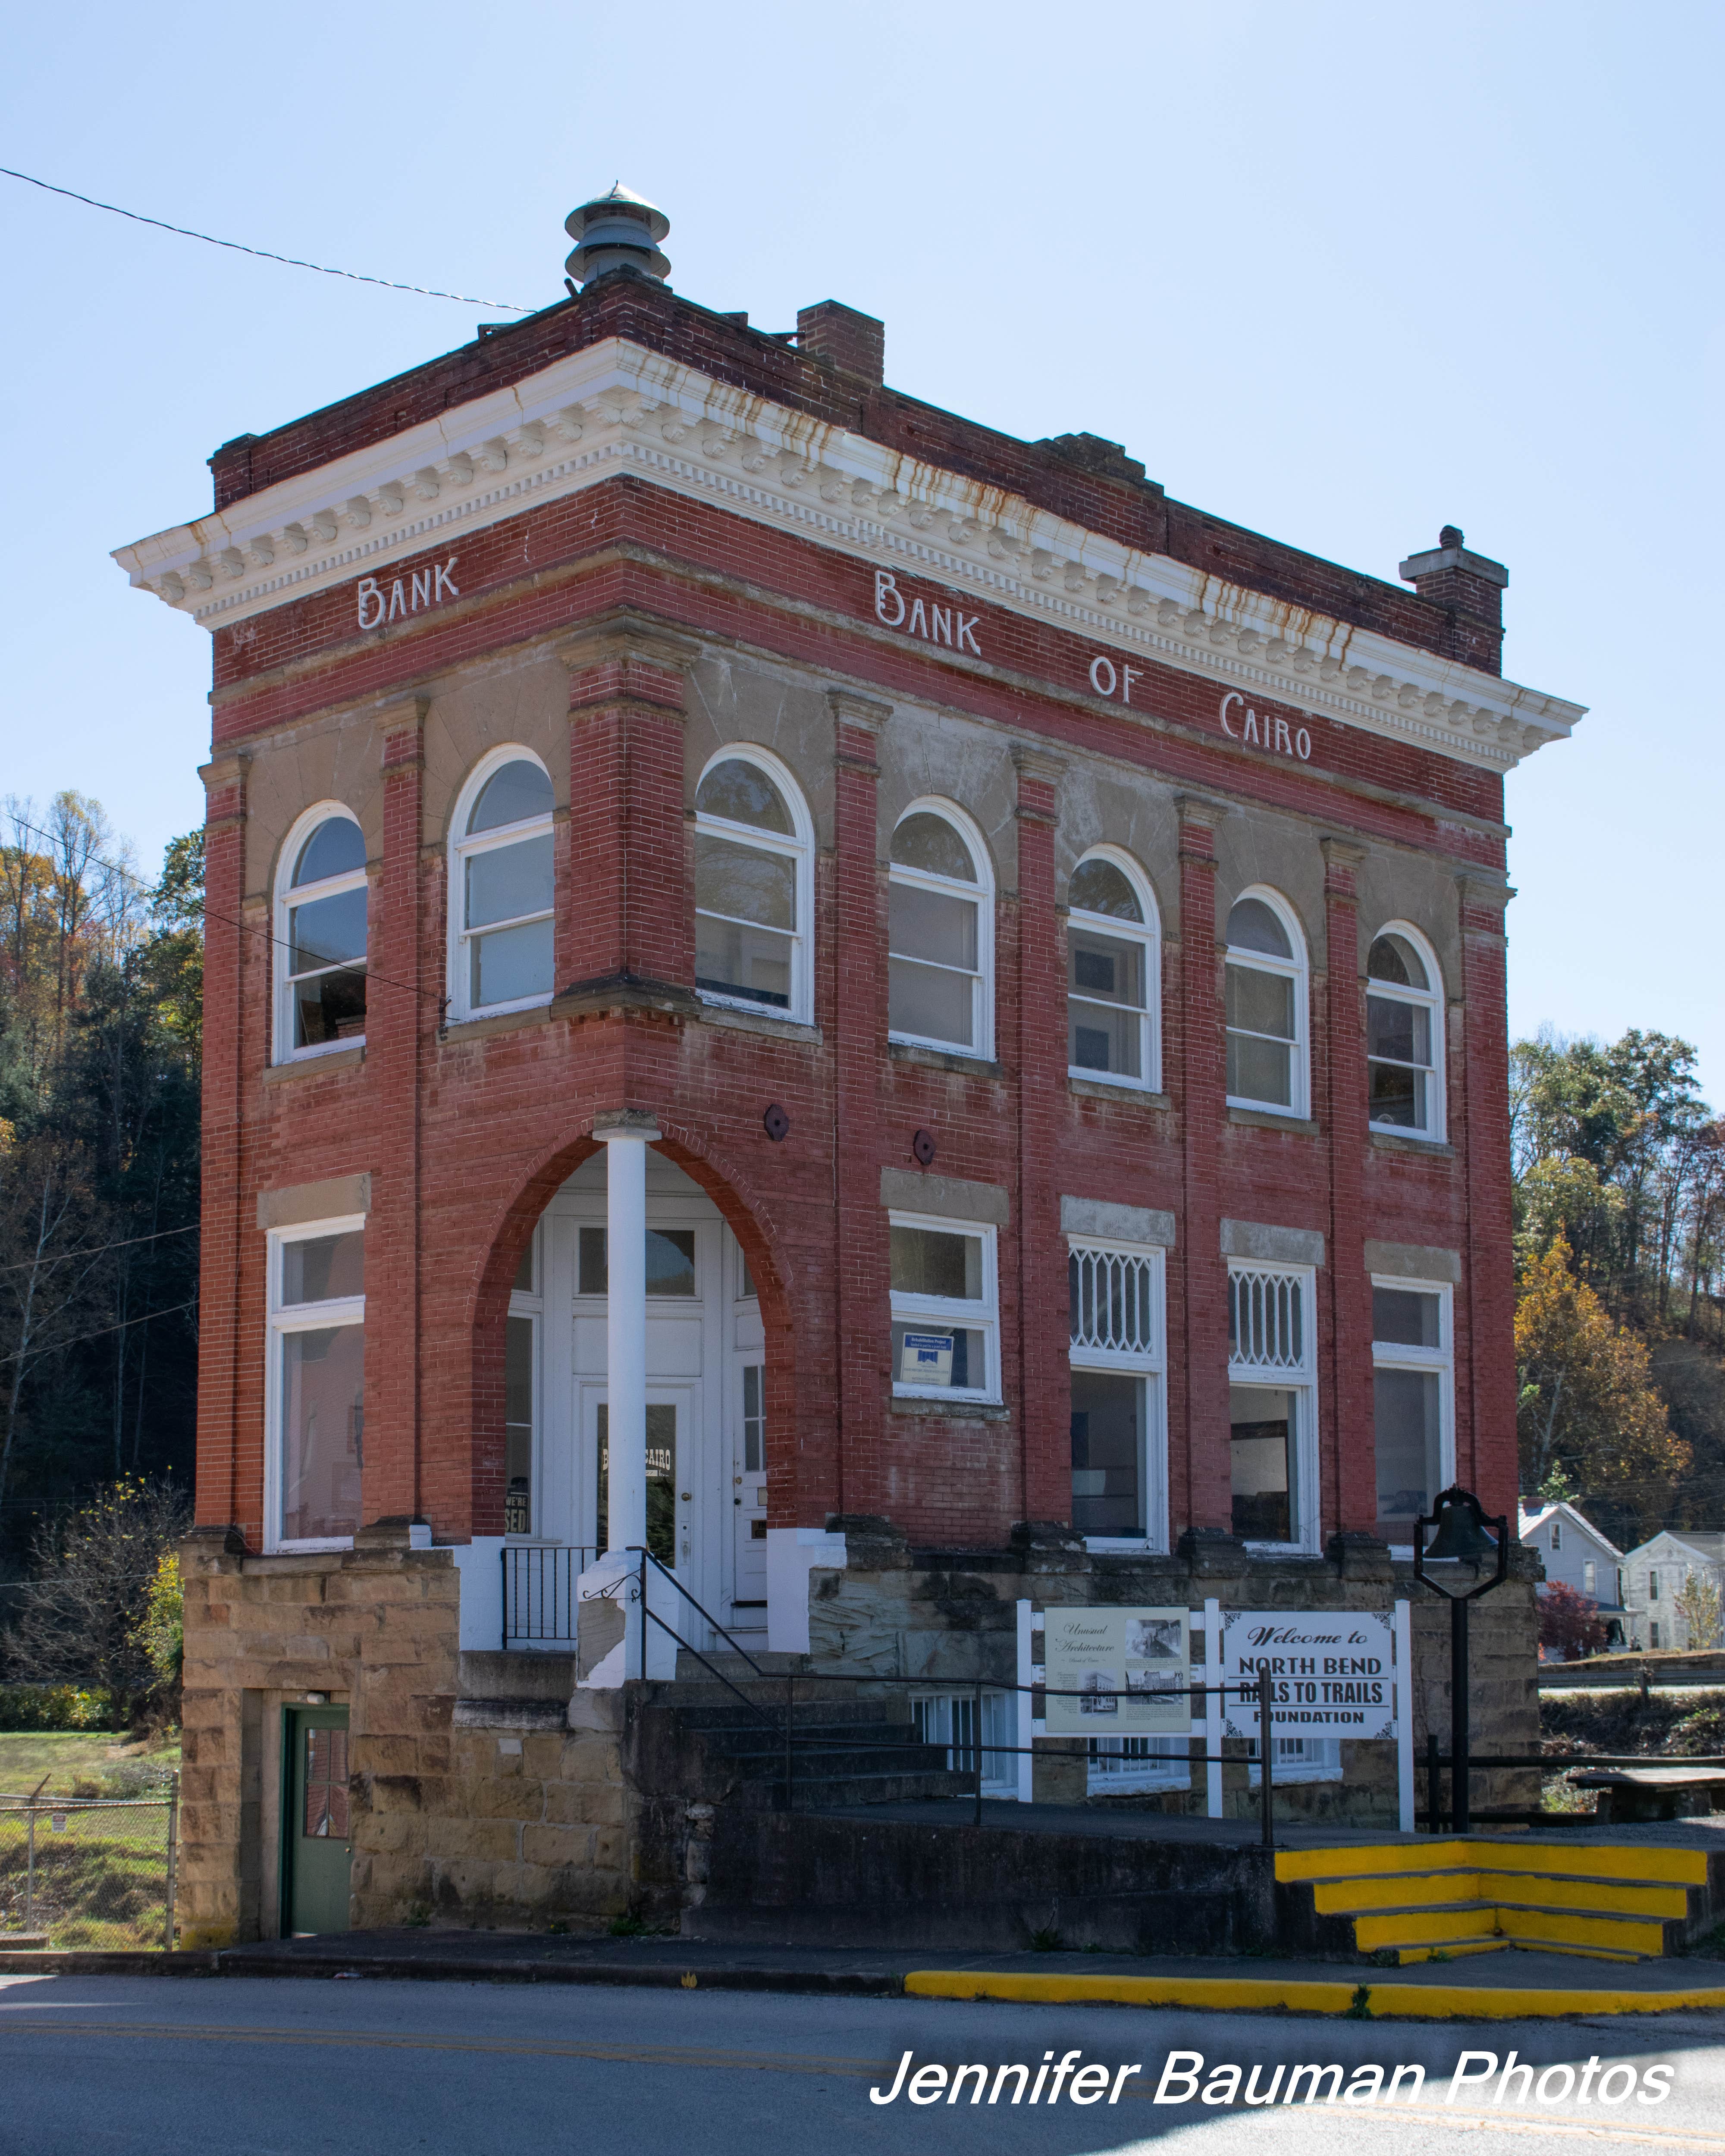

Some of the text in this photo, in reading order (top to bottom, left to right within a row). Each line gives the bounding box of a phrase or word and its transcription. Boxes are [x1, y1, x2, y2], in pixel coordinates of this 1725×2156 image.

[358, 557, 459, 629] BANK
[875, 570, 1311, 760] BANK OF CAIRO
[505, 1496, 527, 1507] WE'RE
[505, 1508, 526, 1532] SED
[1063, 1623, 1108, 1635] Unusual
[1248, 1626, 1368, 1646] Welcome to
[1055, 1639, 1114, 1652] Architecture
[1239, 1657, 1381, 1675] NORTH BEND
[1240, 1682, 1383, 1703] RALS TO TRAILS
[1253, 1711, 1364, 1723] FUNDATION
